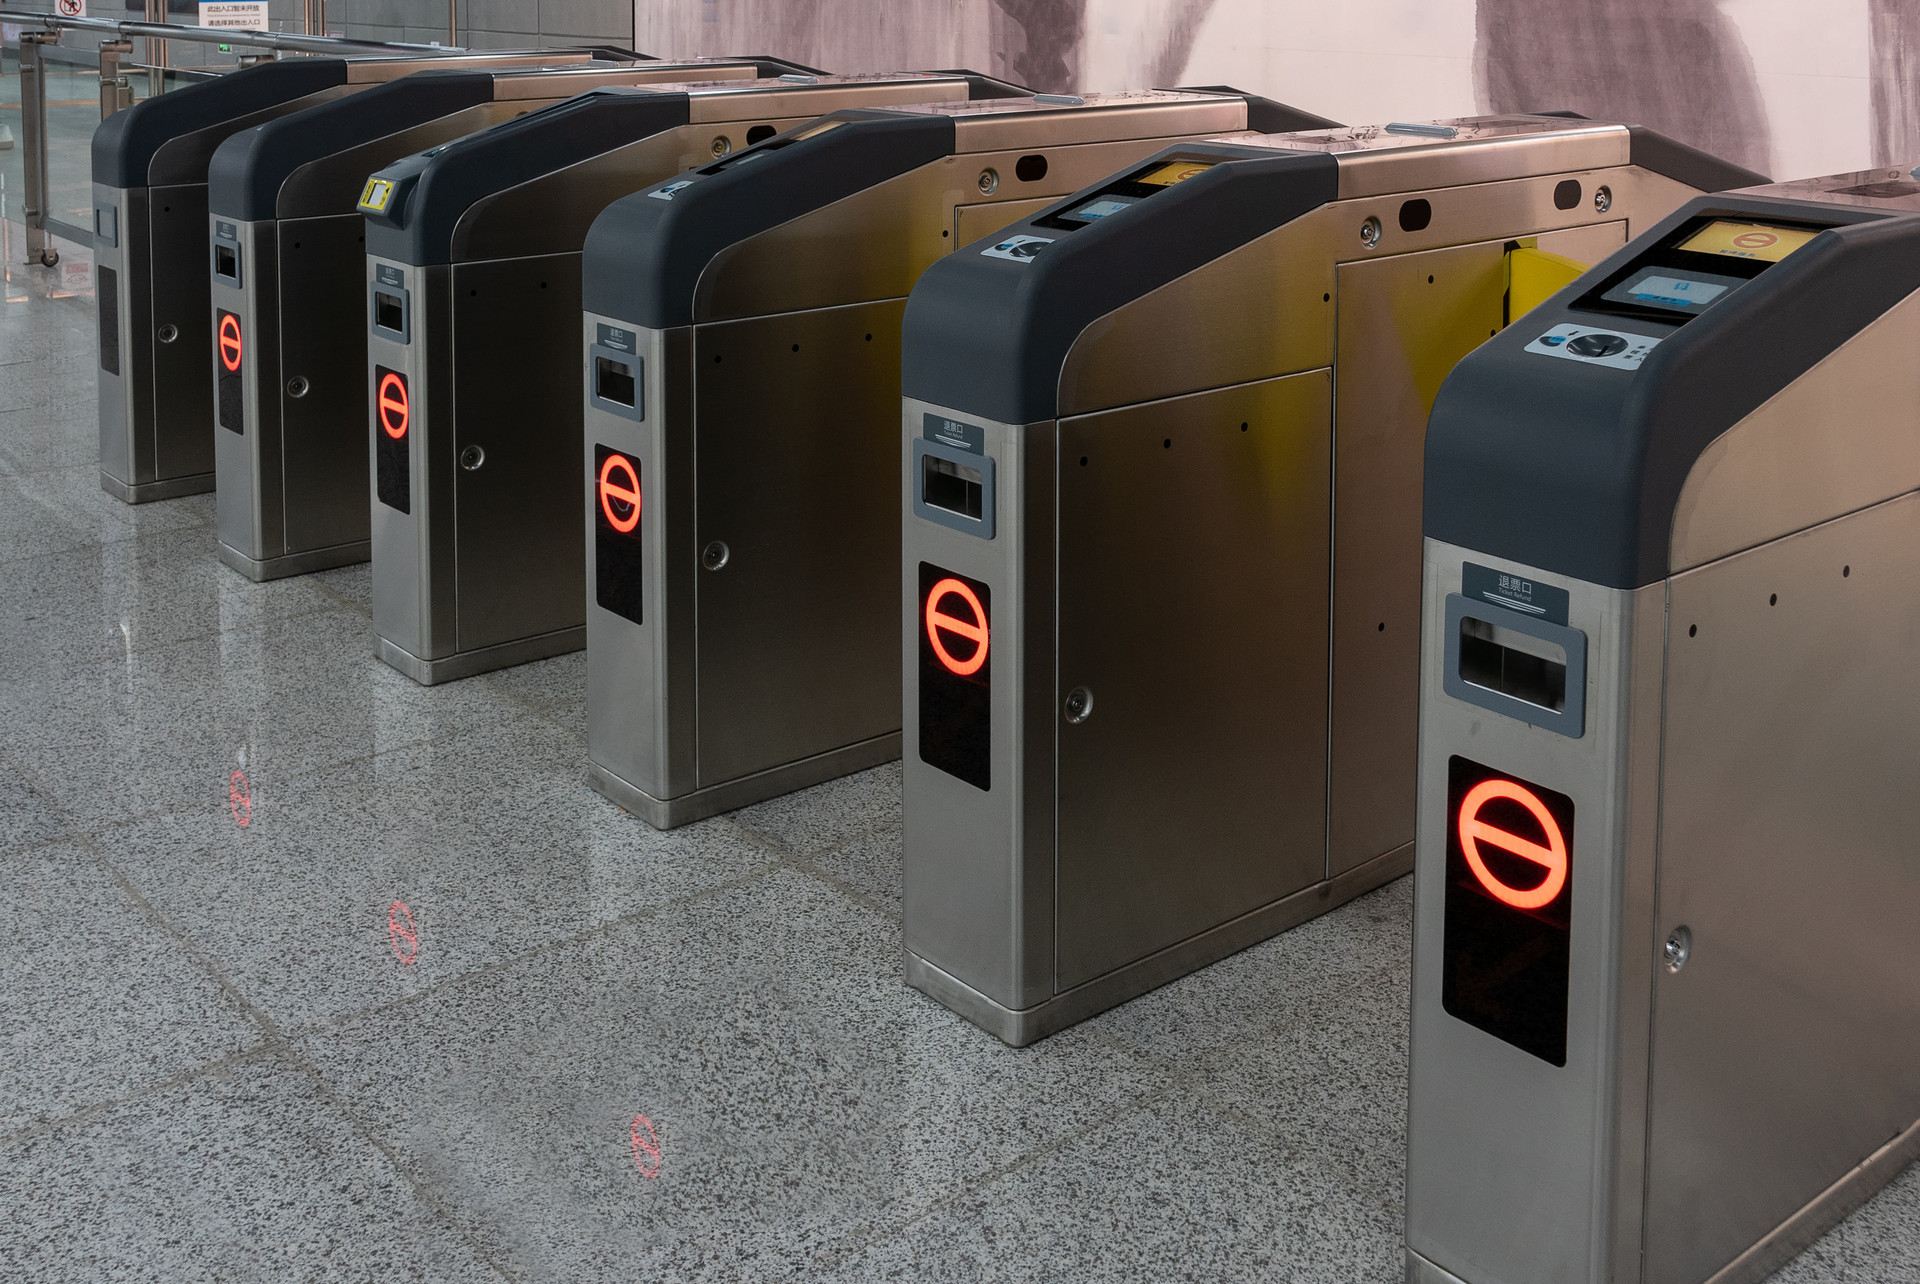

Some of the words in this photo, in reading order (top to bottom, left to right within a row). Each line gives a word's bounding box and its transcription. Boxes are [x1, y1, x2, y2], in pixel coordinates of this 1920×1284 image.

[207, 4, 260, 13] 此出入口暂未开放
[207, 19, 261, 27] 请选择其他出入口
[1498, 574, 1532, 595] 退票口
[1498, 587, 1513, 597] Ticket
[1514, 591, 1532, 602] Refund
